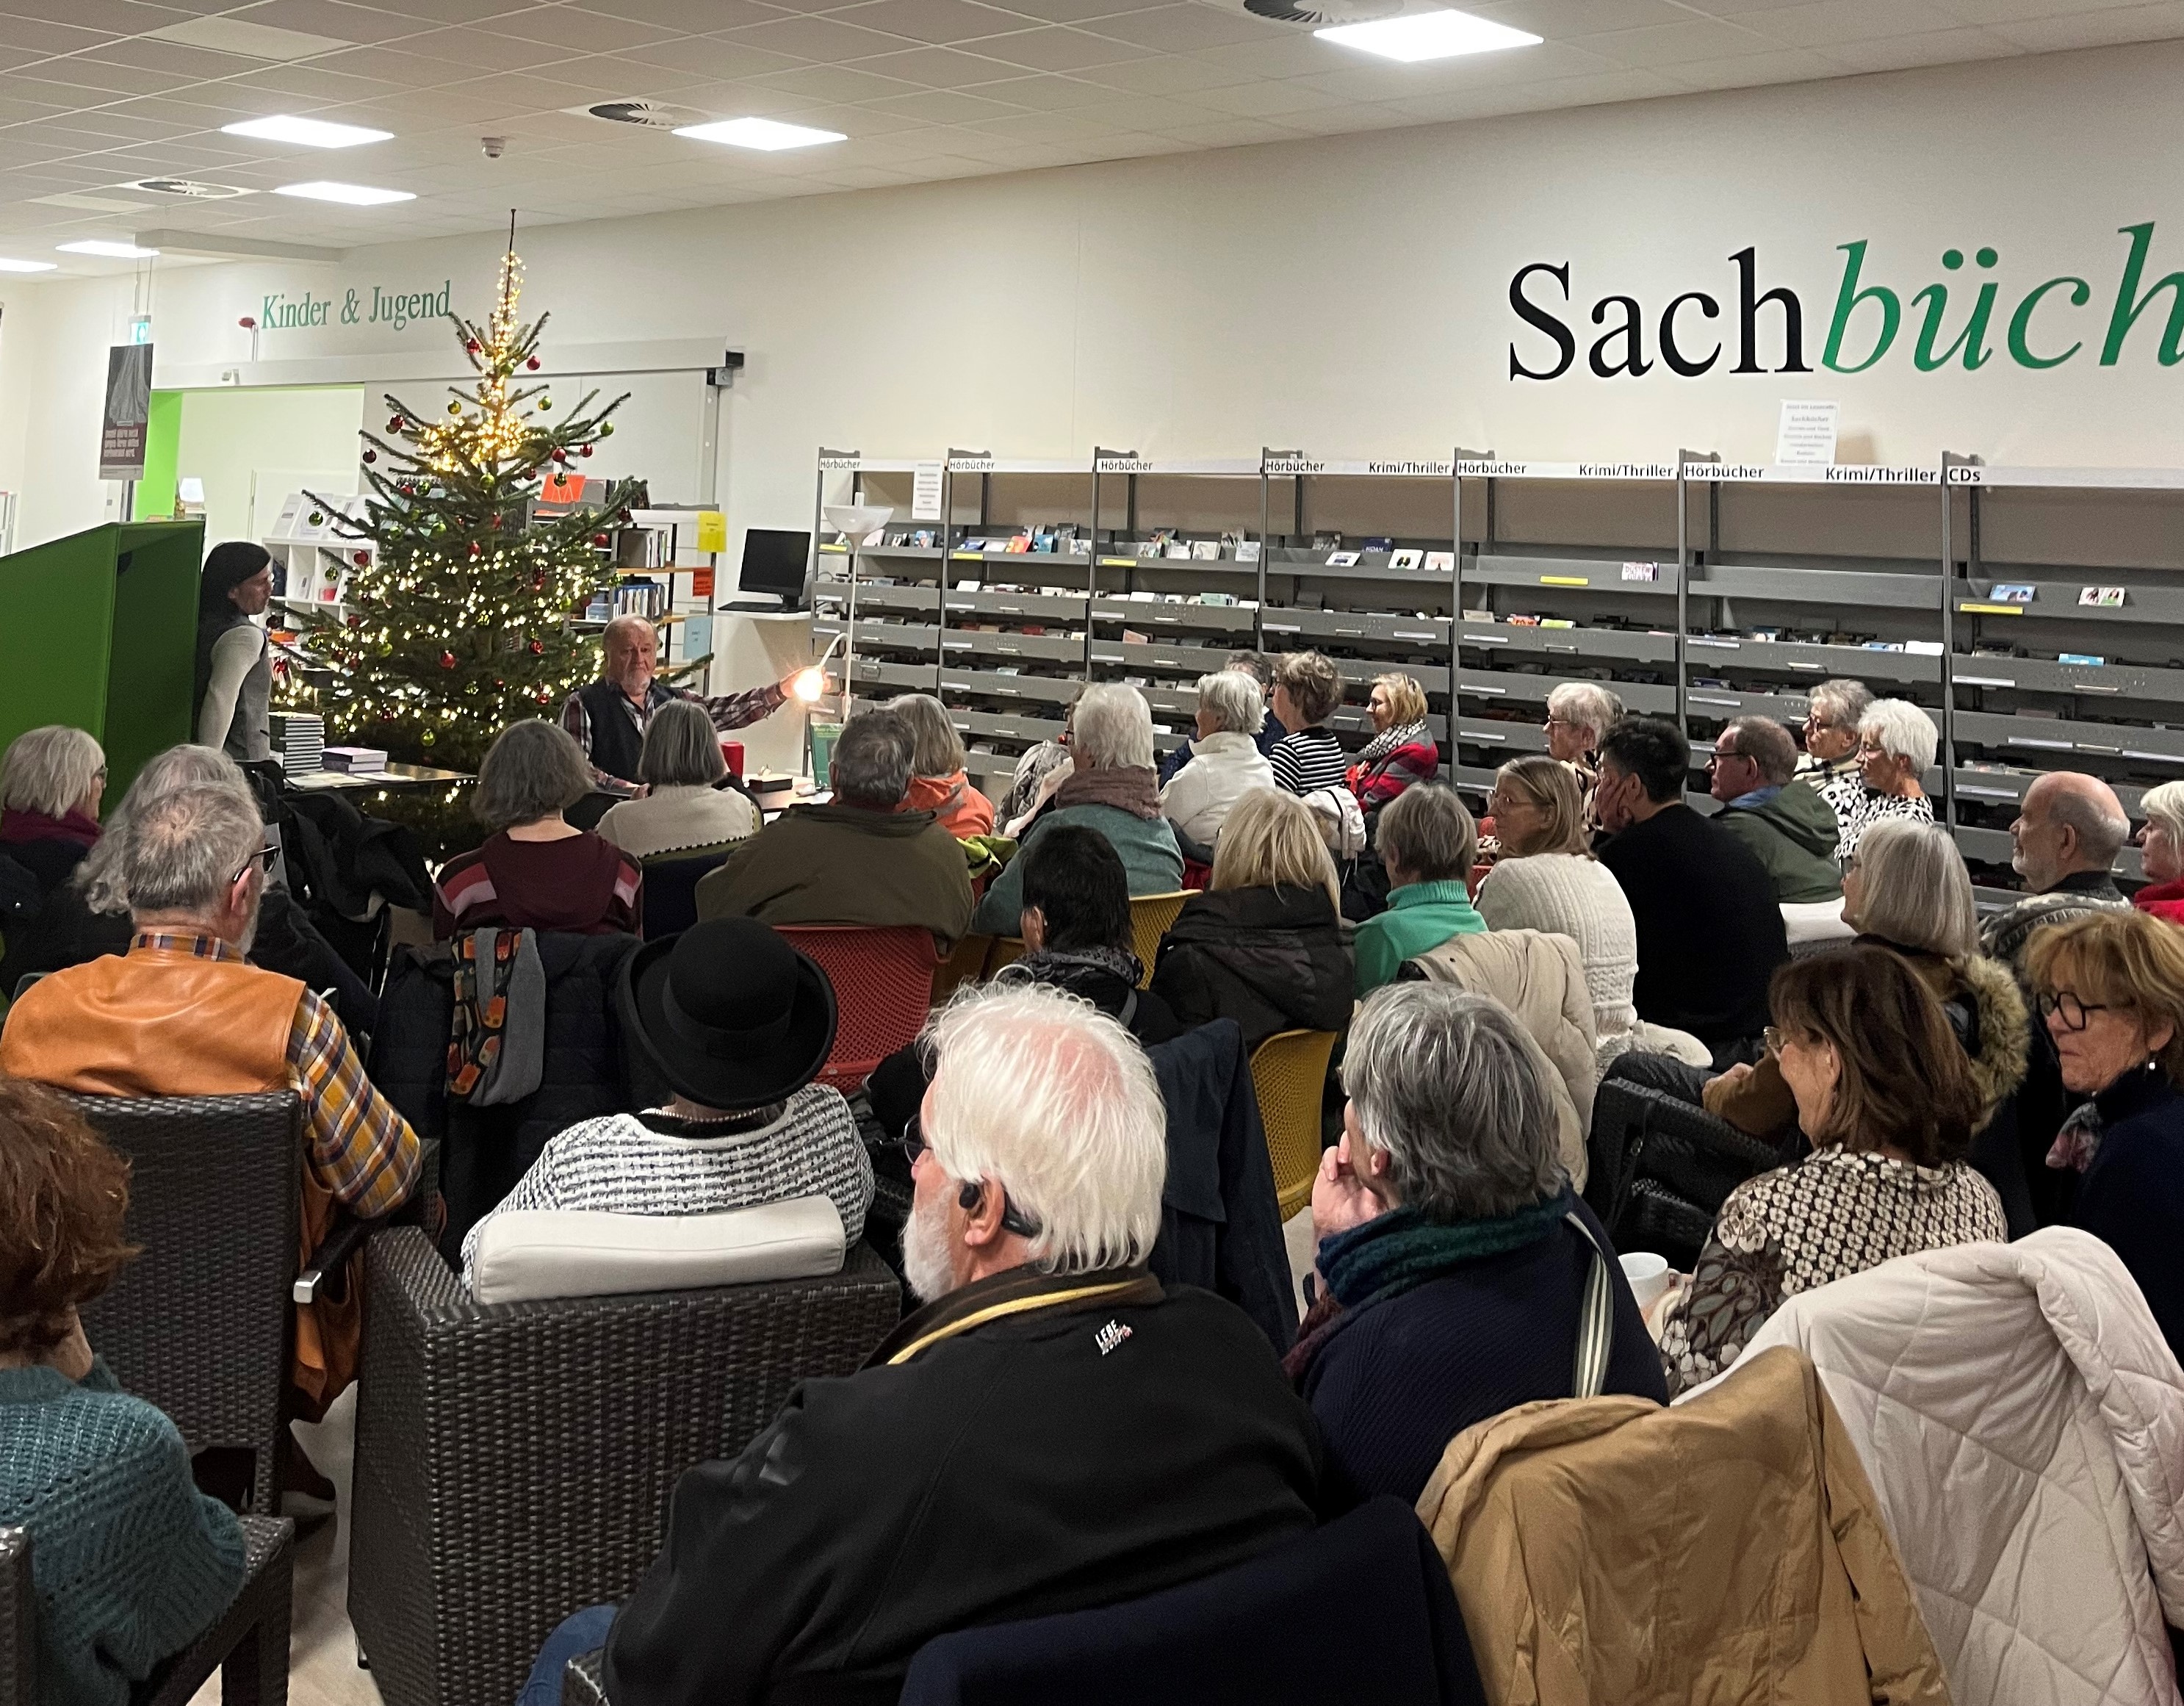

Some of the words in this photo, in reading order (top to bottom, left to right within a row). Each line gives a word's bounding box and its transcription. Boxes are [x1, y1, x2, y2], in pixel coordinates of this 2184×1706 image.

[262, 292, 331, 329] Kinder
[340, 289, 360, 325] &
[369, 280, 450, 331] Jugend
[821, 460, 860, 470] Hörbücher
[950, 461, 995, 470] Hörbücher
[1101, 460, 1153, 471] Hörbücher
[1266, 460, 1325, 472] Hörbücher
[1369, 461, 1450, 474] Krimi/Thriller
[1458, 461, 1527, 474] Hörbücher
[1579, 464, 1673, 478] Krimi/Thriller
[1685, 464, 1765, 478] Hörbücher
[1826, 467, 1936, 482] Krimi/Thriller
[1949, 468, 1981, 482] CDs
